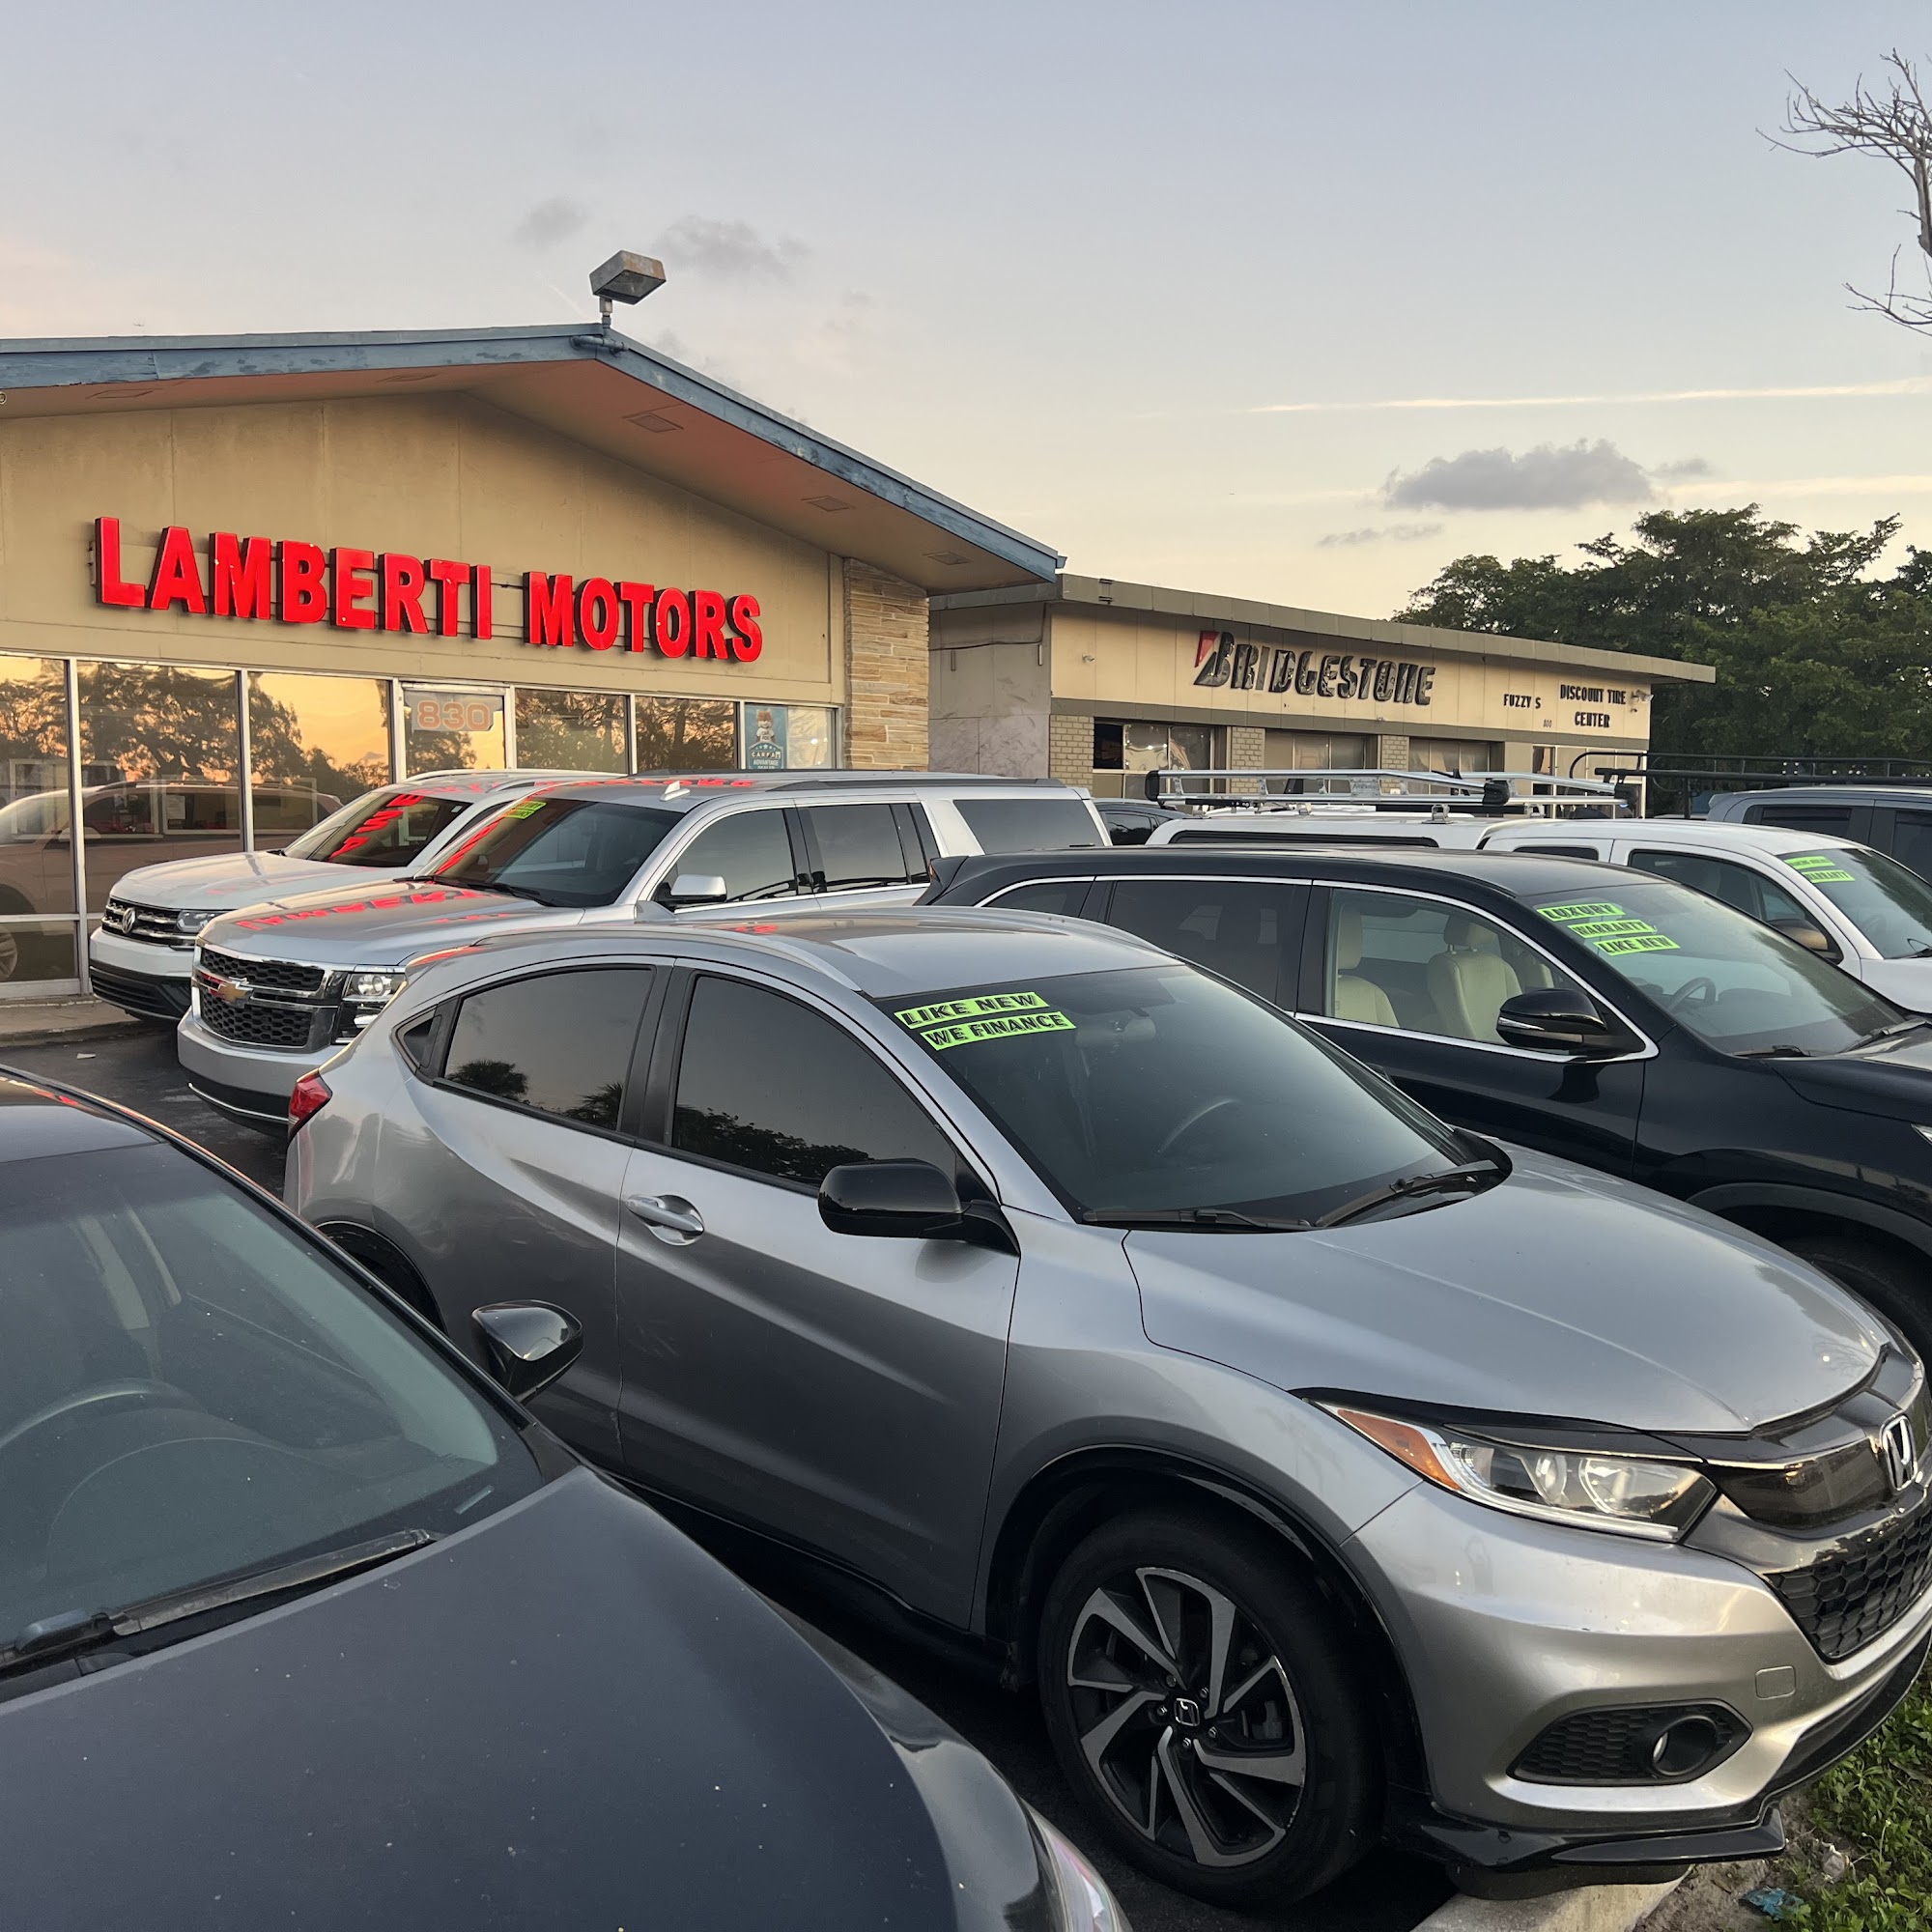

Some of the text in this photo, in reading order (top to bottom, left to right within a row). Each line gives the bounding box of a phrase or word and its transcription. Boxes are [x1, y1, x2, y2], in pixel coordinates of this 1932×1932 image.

[96, 517, 762, 663] LAMBERTI MOTORS
[1193, 631, 1436, 705] BRIDGESTONE
[1503, 694, 1532, 708] FUZZY
[1560, 684, 1627, 705] DISCOUNT TIRE
[417, 699, 491, 731] 830
[1575, 711, 1610, 728] CENTER
[1545, 903, 1618, 920] LUXURY
[1574, 921, 1651, 936] WARRANTY
[1599, 936, 1673, 953] LIKE NEW
[901, 994, 1036, 1026] LIKE NEW
[925, 1014, 1067, 1045] WE FINANCE
